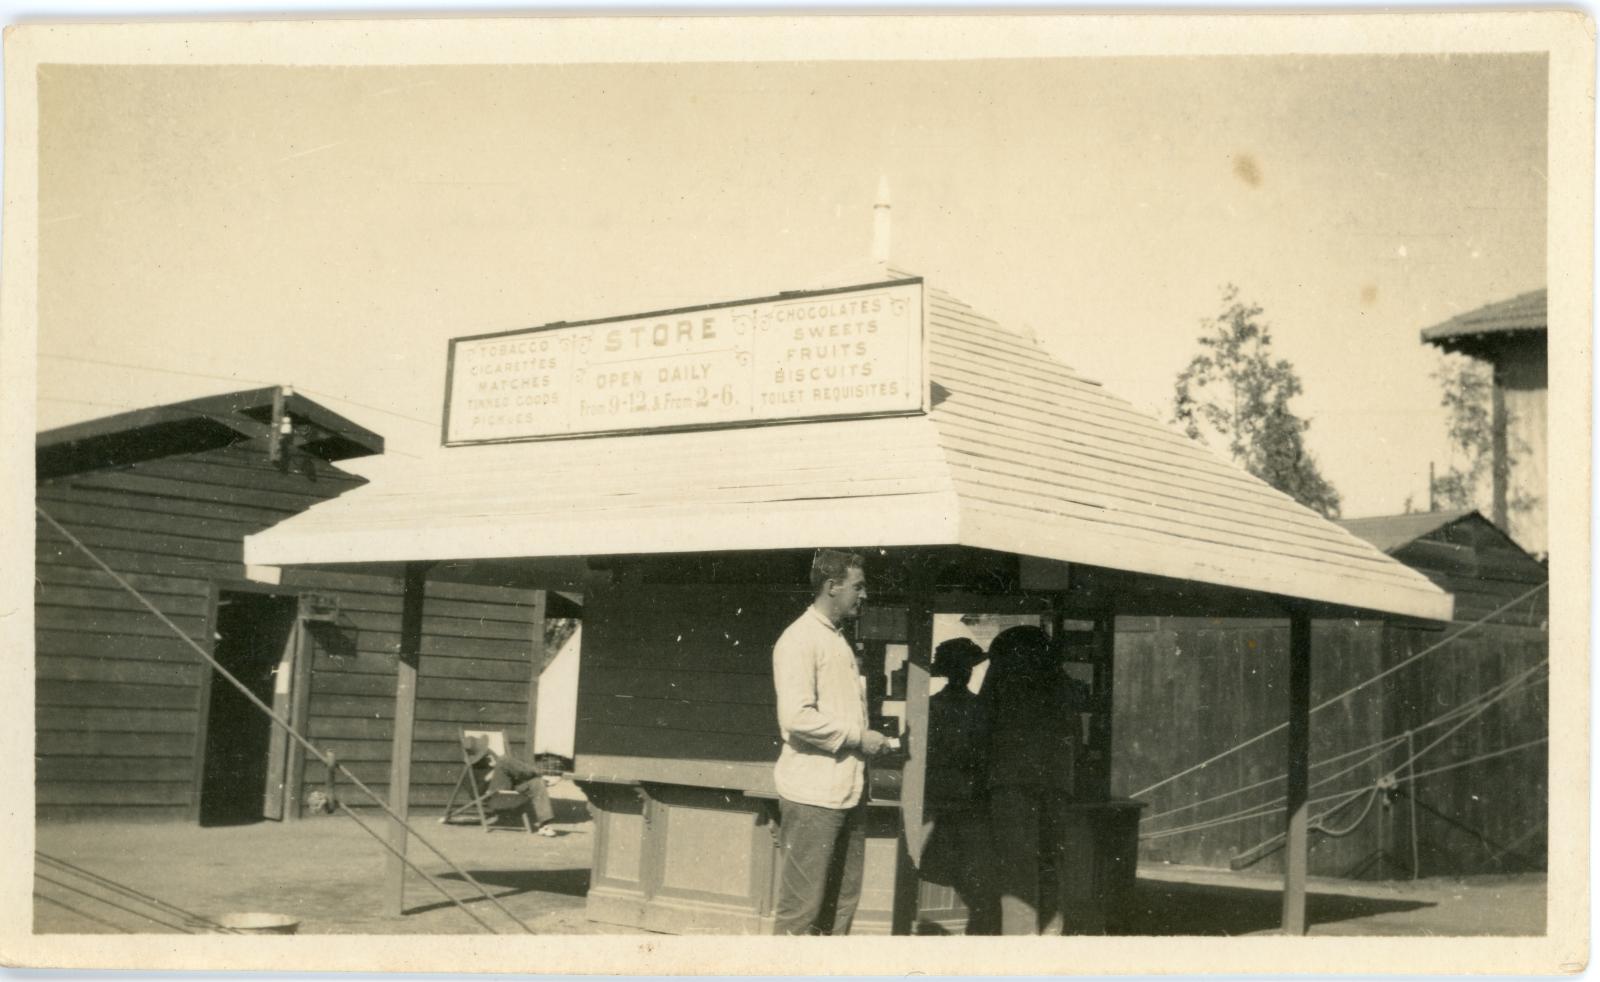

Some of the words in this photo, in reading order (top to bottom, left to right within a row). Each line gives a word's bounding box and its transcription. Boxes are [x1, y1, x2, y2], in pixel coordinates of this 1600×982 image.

[776, 299, 882, 322] CHOCOLATES
[604, 317, 716, 352] STORE
[793, 320, 878, 341] SWEETS
[480, 340, 549, 357] TOBACCO
[786, 341, 867, 361] FRUITS
[478, 375, 550, 391] MATCHES
[596, 370, 643, 389] OPEN
[658, 363, 711, 383] DAILY
[774, 362, 872, 383] BISCUITS
[761, 390, 804, 405] TOILET
[813, 381, 898, 402] REQUISITES
